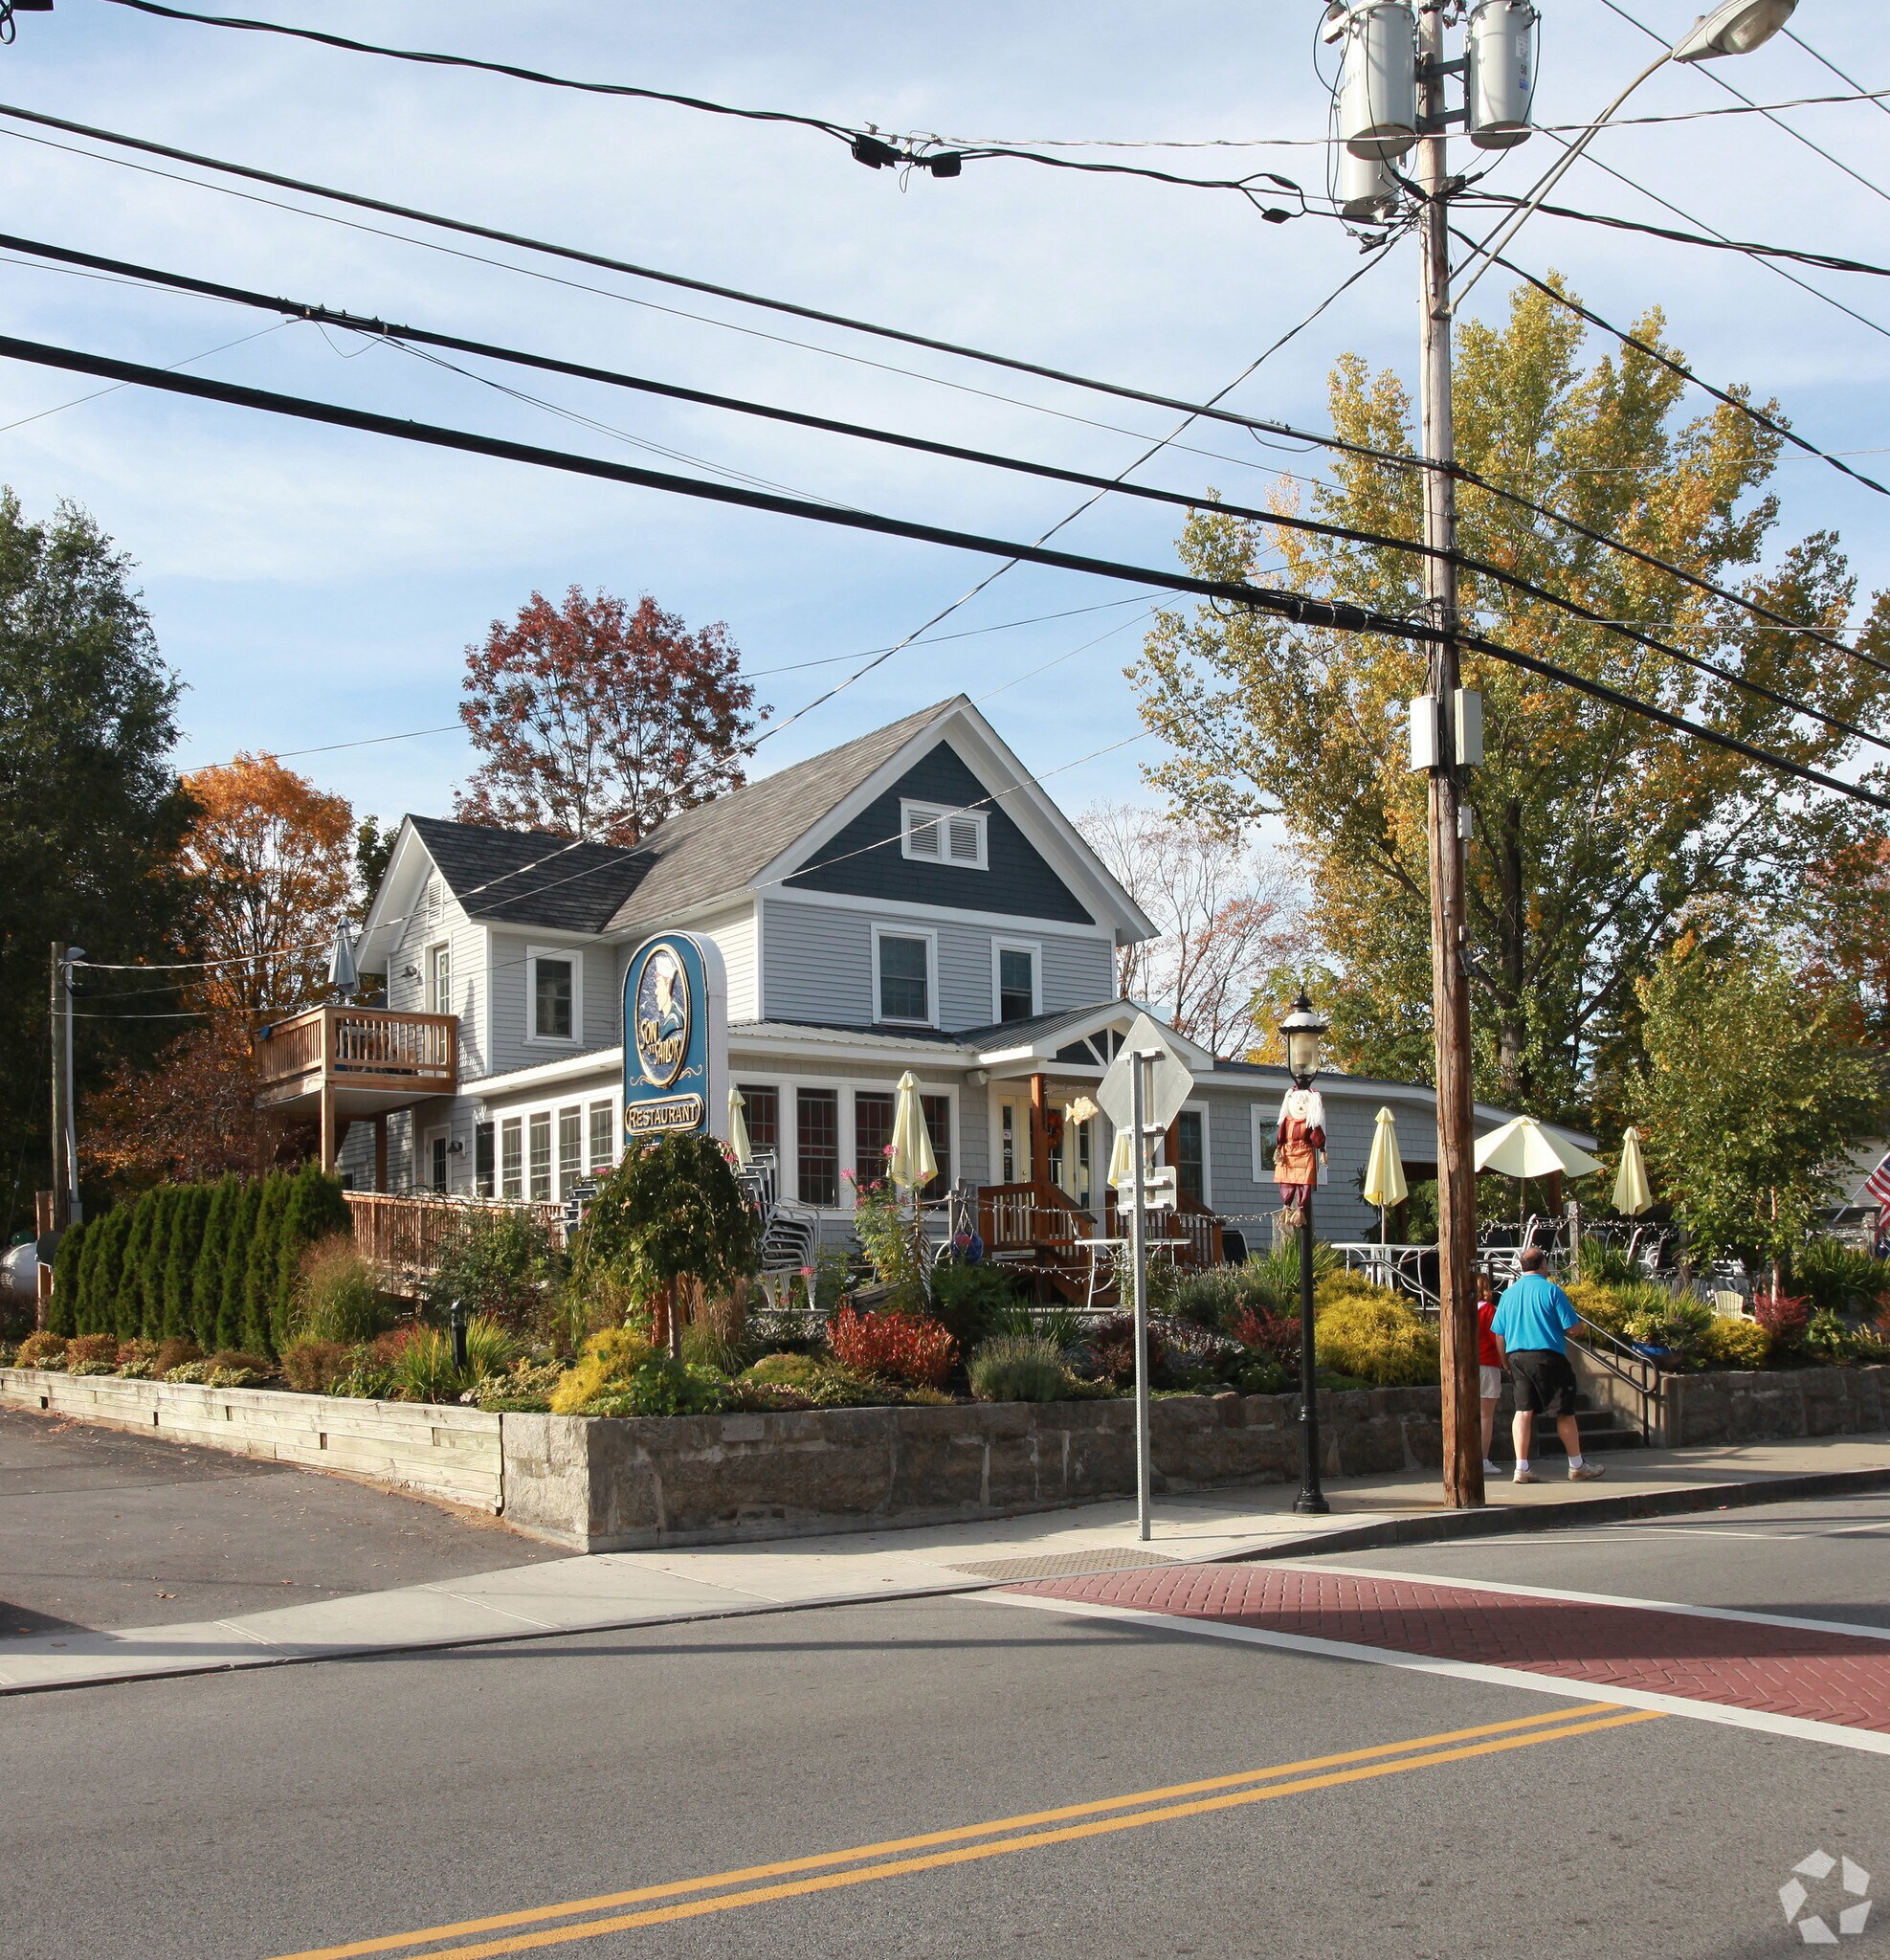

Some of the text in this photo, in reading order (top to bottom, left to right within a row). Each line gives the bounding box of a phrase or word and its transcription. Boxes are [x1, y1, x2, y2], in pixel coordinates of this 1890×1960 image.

[640, 1017, 658, 1050] SON
[654, 1036, 679, 1064] SAILOR
[629, 1103, 697, 1127] RESTAURANT
